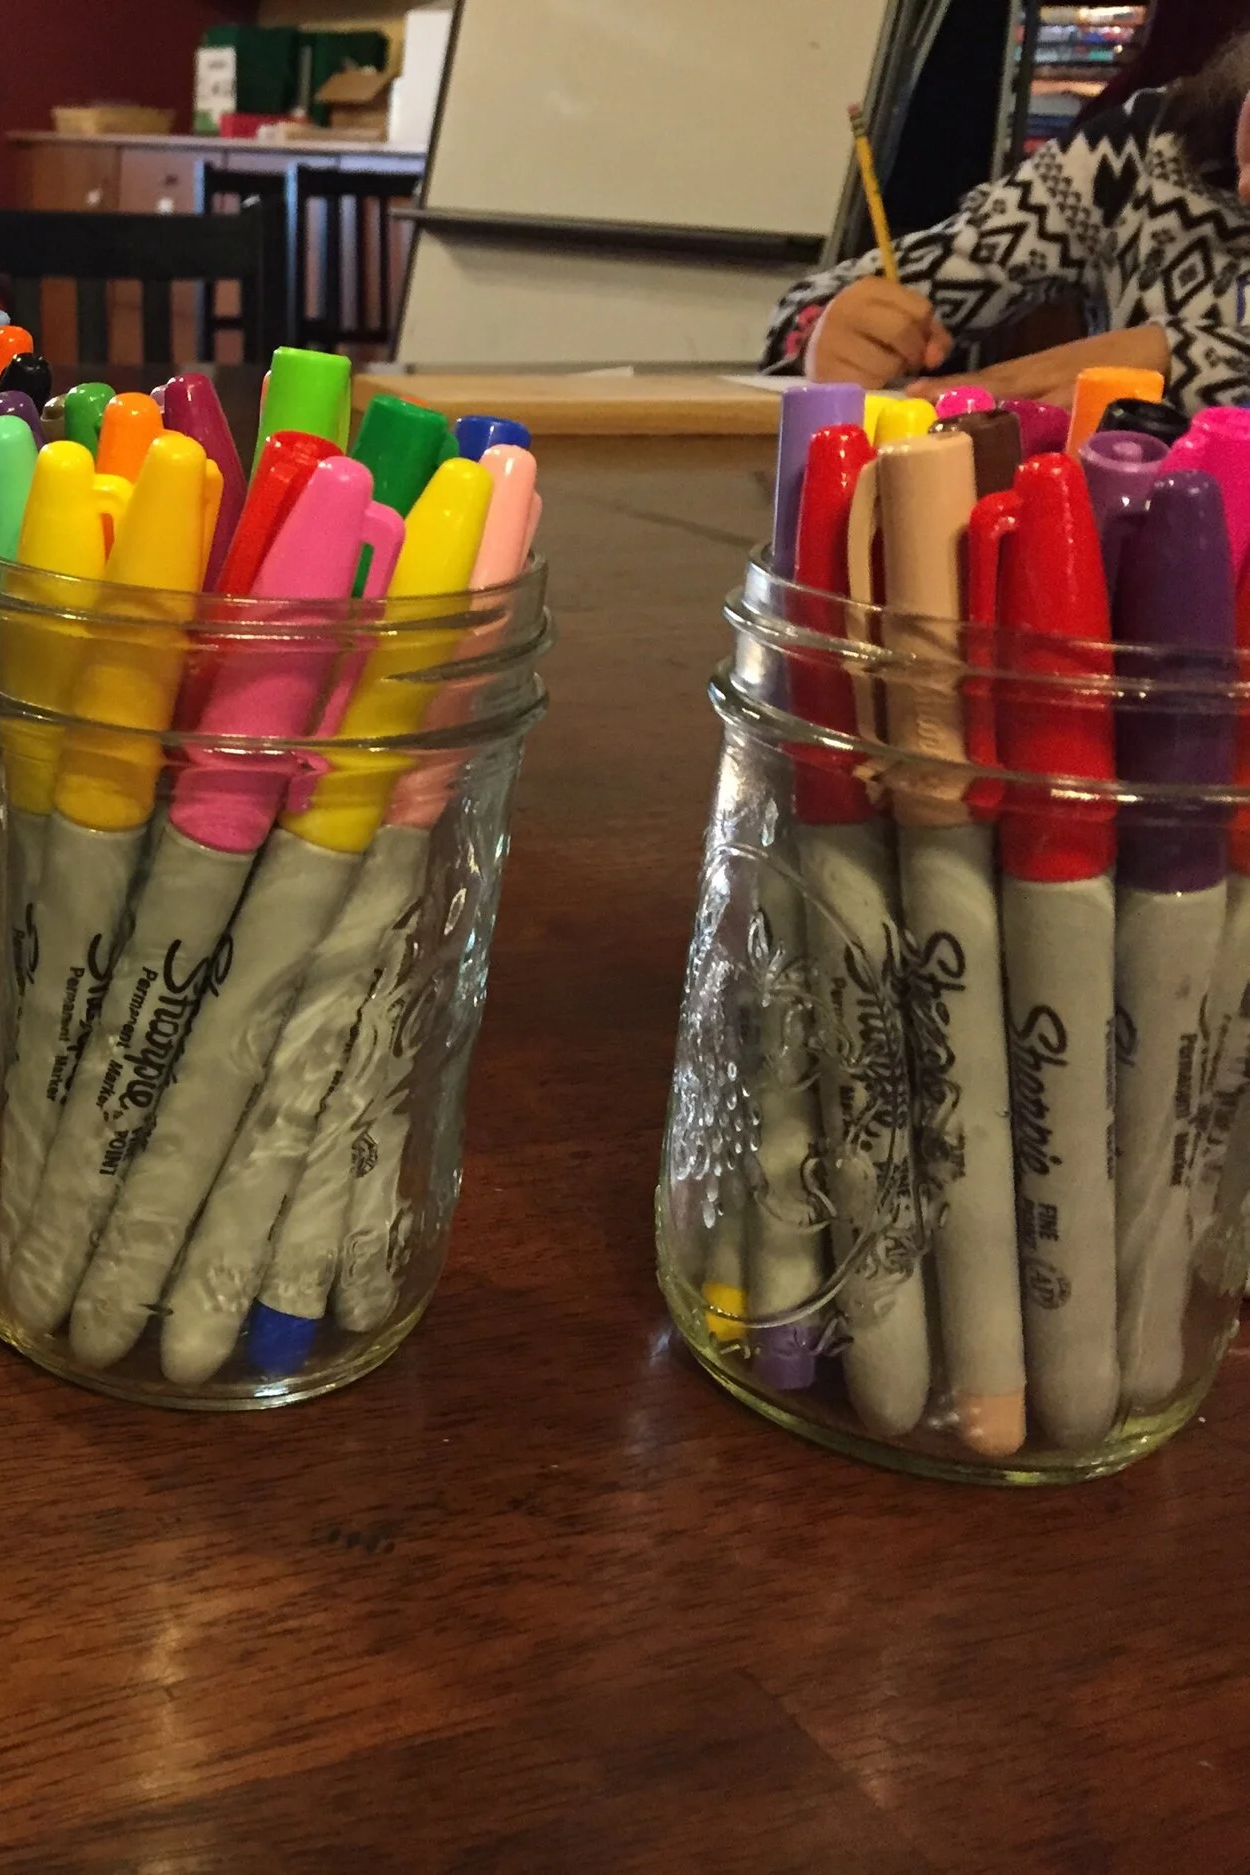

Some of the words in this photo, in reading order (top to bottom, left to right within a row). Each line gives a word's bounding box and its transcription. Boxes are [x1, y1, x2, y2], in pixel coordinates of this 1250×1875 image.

[59, 966, 86, 1042] Permanent
[118, 966, 159, 1049] Permanent
[46, 1054, 69, 1103] Marker
[96, 1058, 124, 1108] Marker
[1011, 1003, 1070, 1177] Sharpie
[99, 1129, 129, 1177] POINT
